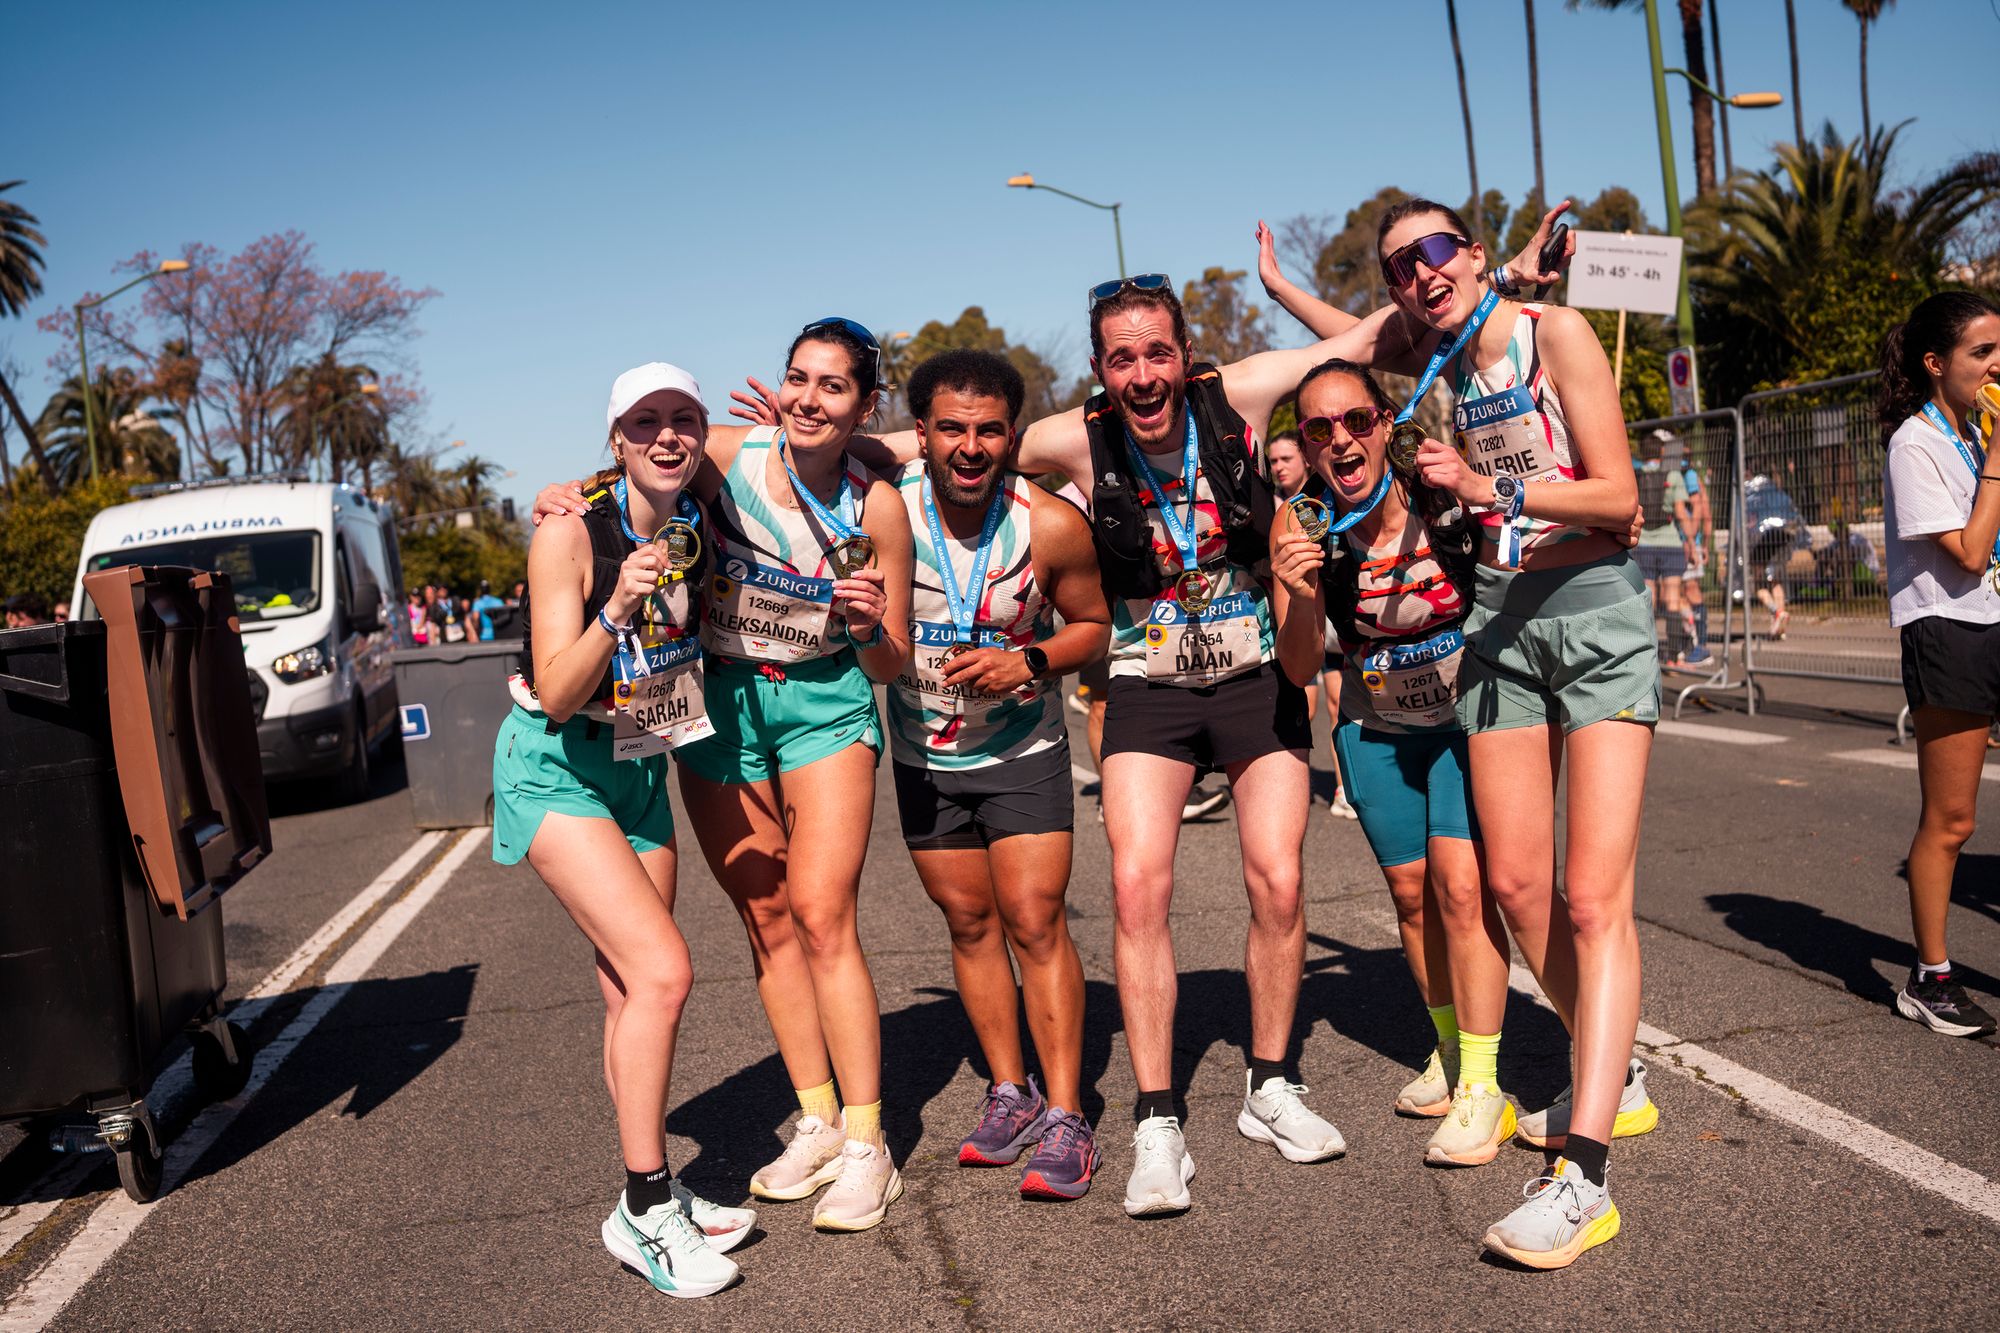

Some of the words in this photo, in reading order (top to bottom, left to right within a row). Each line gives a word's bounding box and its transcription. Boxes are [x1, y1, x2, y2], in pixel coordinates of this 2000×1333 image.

[1587, 264, 1605, 277] 3h
[1643, 268, 1661, 281] 4h
[1470, 397, 1518, 422] ZURICH
[1188, 438, 1197, 463] SEVILLA
[1477, 434, 1506, 454] 12821
[1164, 505, 1184, 537] ZURICH
[928, 511, 941, 543] ZURICH
[936, 545, 951, 580] MARATÓN
[945, 578, 958, 606] SEVILLA
[754, 571, 819, 598] ZURICH
[968, 574, 982, 607] ZURICH
[748, 595, 790, 616] 12669
[708, 606, 820, 648] ALEKSANDRA
[928, 629, 990, 644] ZUCH
[1183, 632, 1224, 648] 11954
[1399, 635, 1456, 666] ZURICH
[650, 643, 696, 669] ZURICH
[1175, 650, 1233, 673] DAAN
[647, 679, 676, 700] 12678
[1401, 670, 1441, 691] 12671
[1395, 681, 1454, 710] KELLY
[635, 696, 689, 732] SARAH
